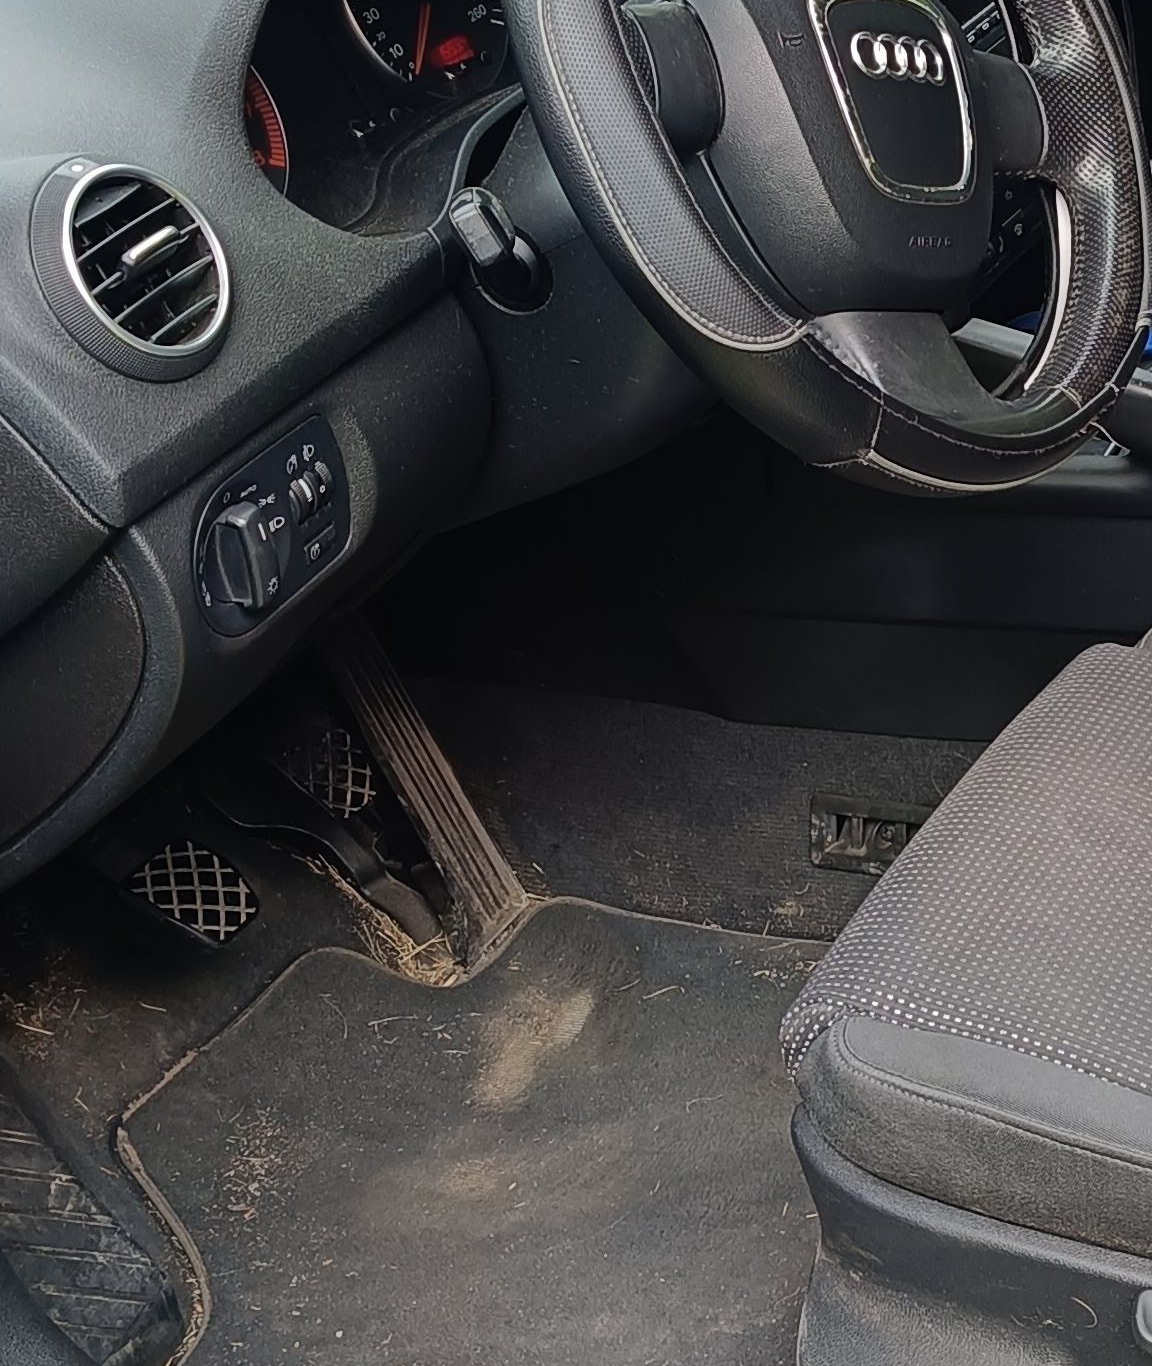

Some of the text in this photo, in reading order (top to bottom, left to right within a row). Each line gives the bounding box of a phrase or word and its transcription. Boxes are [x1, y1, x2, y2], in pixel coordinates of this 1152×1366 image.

[363, 7, 380, 24] 30
[467, 4, 487, 23] 260
[389, 43, 404, 59] 10
